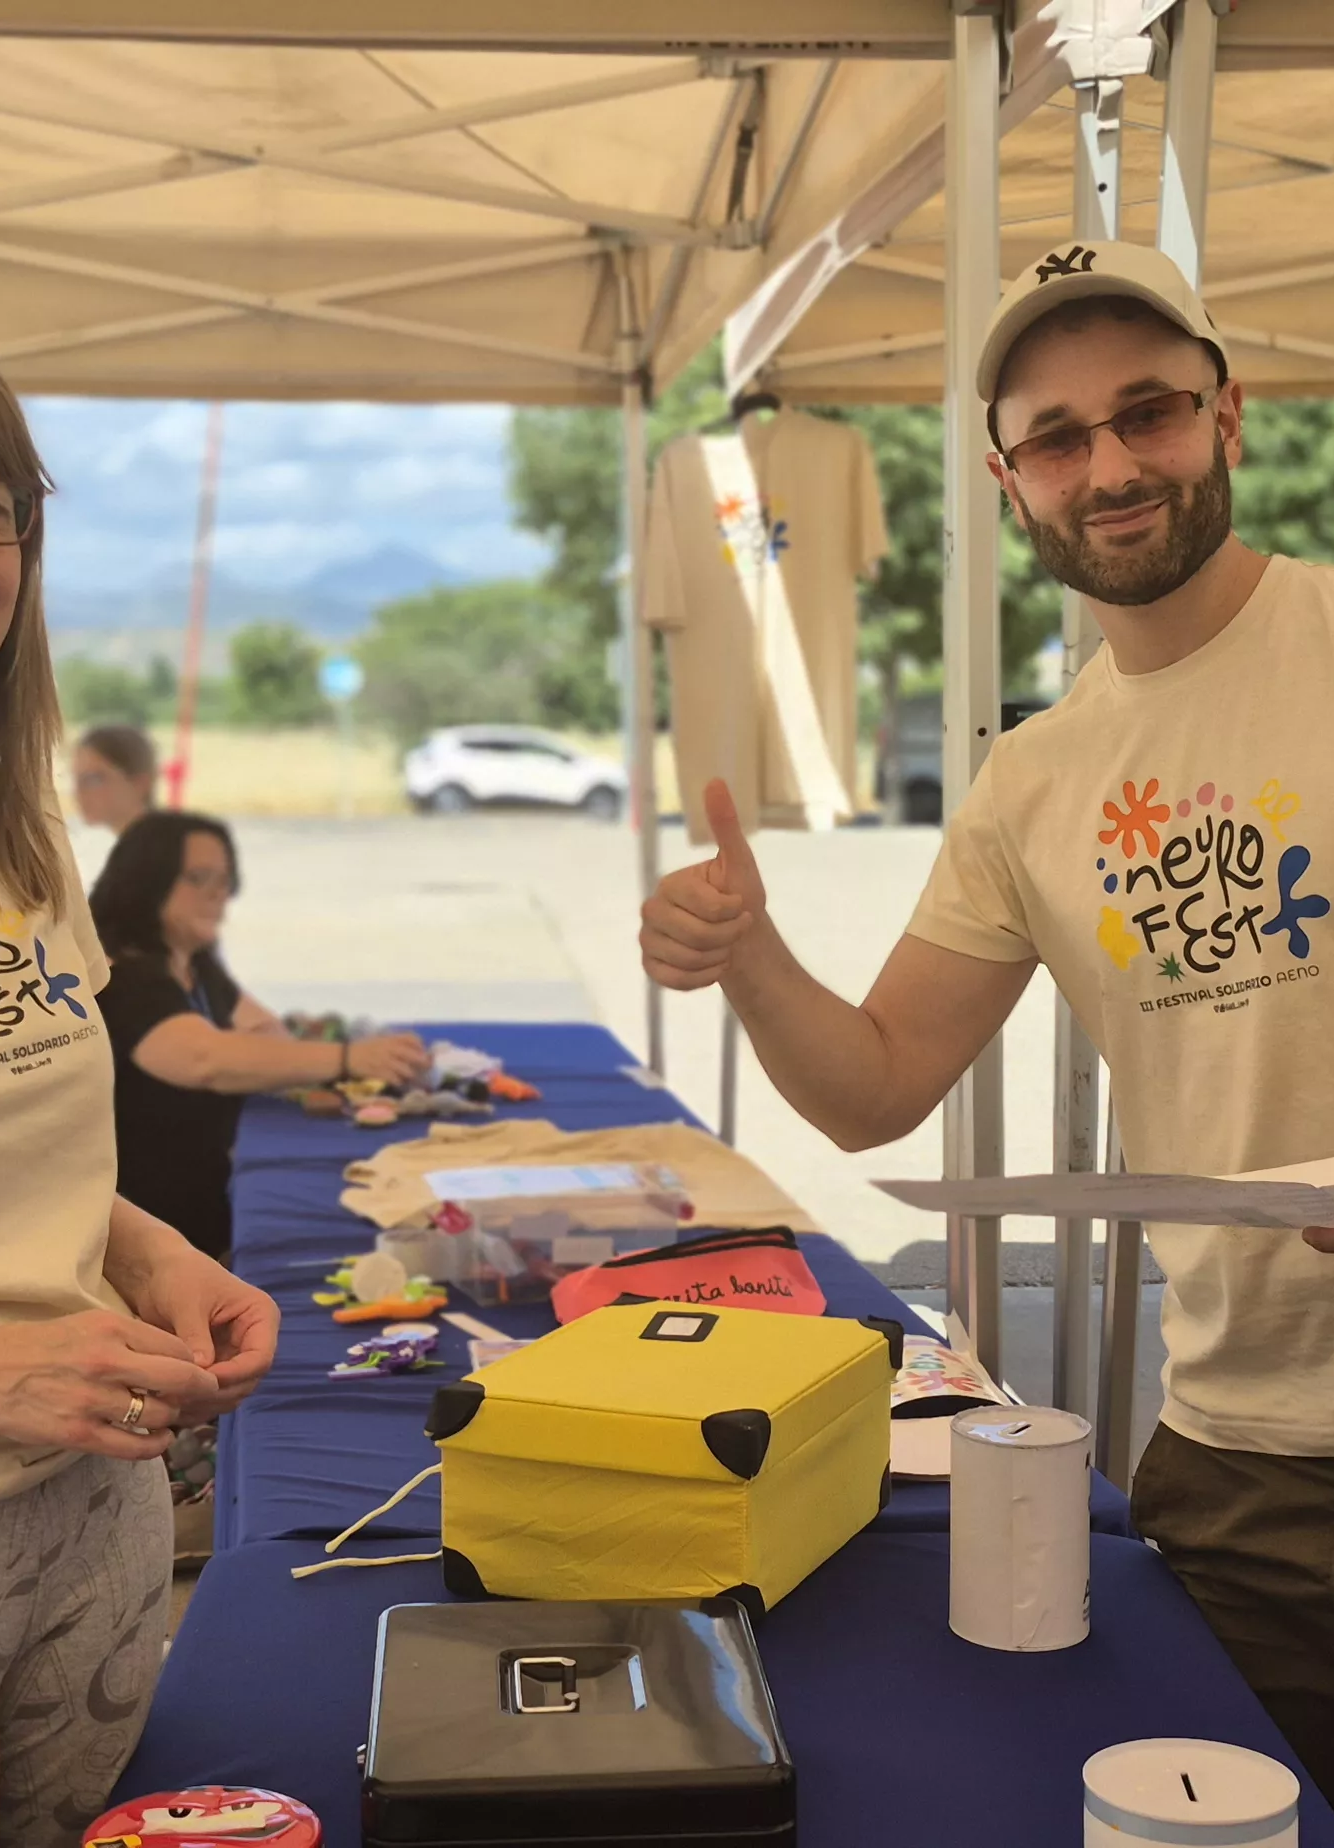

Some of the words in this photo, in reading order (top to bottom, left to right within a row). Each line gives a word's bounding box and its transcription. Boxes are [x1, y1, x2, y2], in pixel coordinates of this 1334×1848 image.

[1156, 989, 1214, 1010] FESTIVAL
[1215, 975, 1272, 998] SOLIDARIO
[12, 1033, 71, 1060] SOLIDARIO
